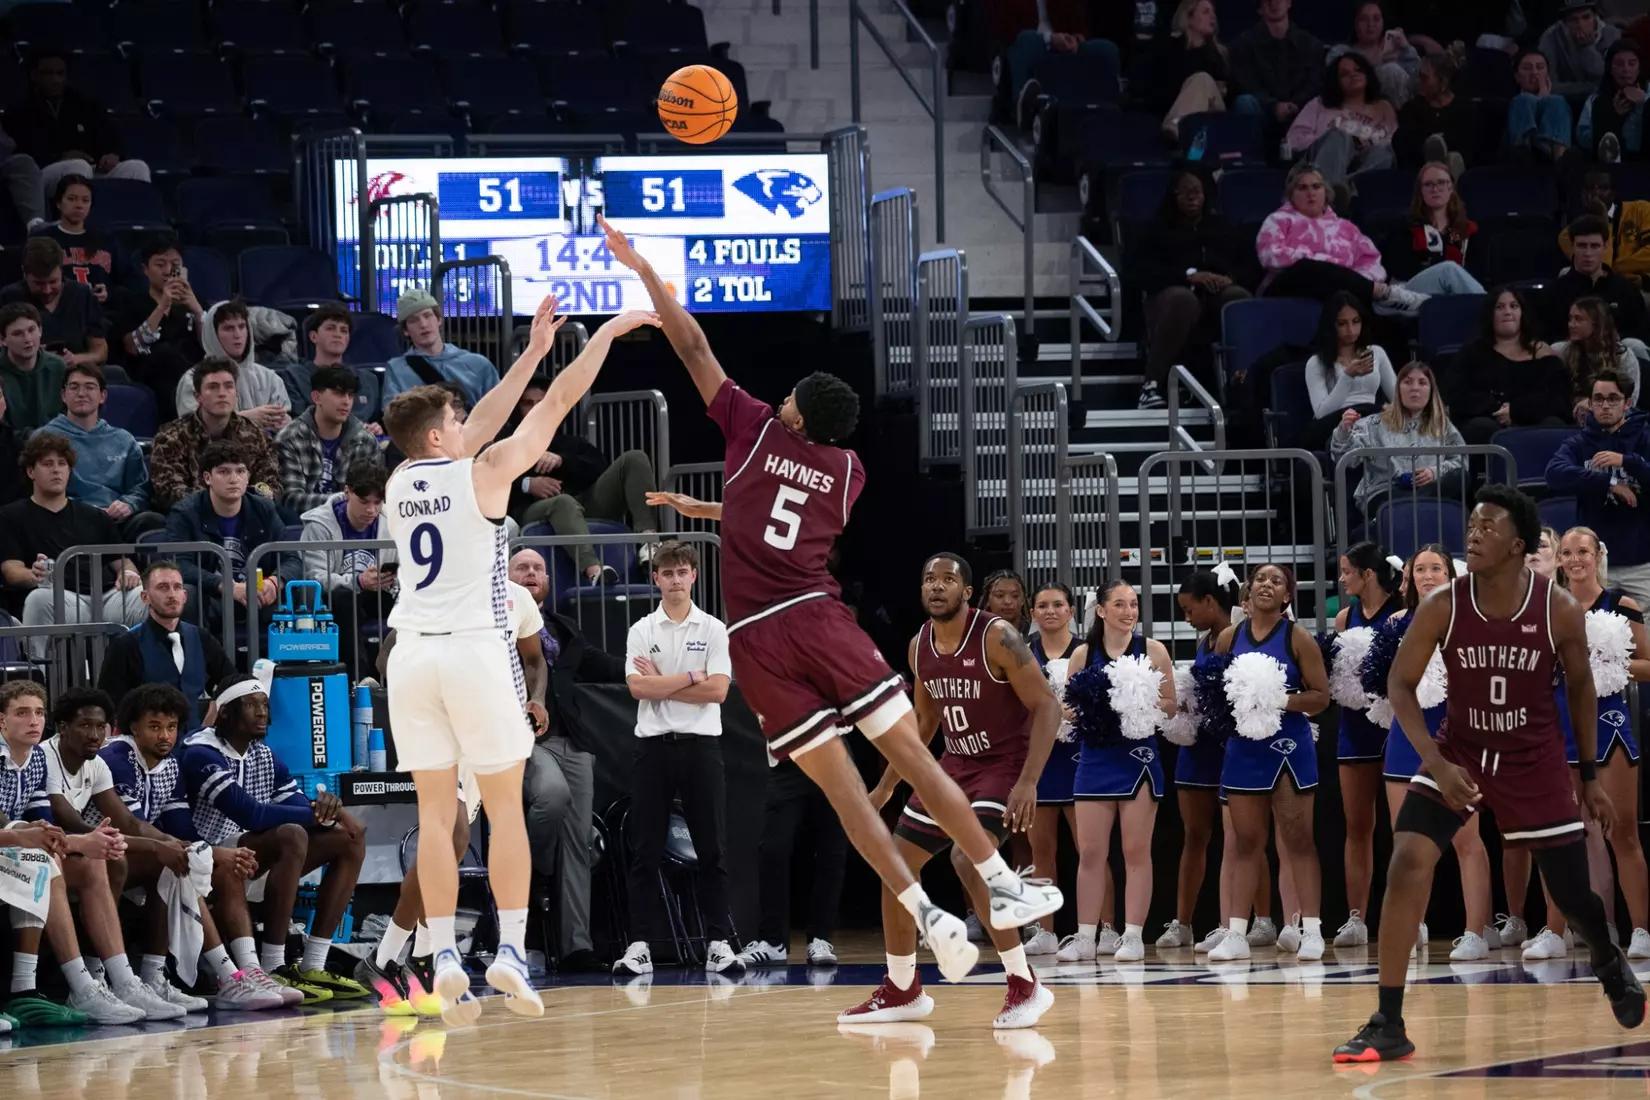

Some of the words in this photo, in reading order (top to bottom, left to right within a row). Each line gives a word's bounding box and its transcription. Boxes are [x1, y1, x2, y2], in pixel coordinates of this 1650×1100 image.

[479, 177, 523, 212] 51
[562, 179, 605, 207] VS
[642, 177, 686, 212] 51
[536, 238, 635, 271] 14:4
[689, 239, 707, 265] 4
[714, 238, 800, 265] FOULS
[551, 281, 623, 312] 2ND
[694, 276, 713, 302] 2
[719, 276, 772, 302] TOL
[764, 453, 835, 494] HAYNES
[398, 495, 451, 518] CONRAD
[763, 483, 810, 551] 5
[409, 522, 444, 592] 9
[279, 643, 331, 651] POWERADE
[1456, 645, 1541, 672] SOUTHERN
[923, 677, 981, 700] SOUTHERN
[1490, 675, 1507, 706] 0
[311, 682, 326, 764] POWERADE
[943, 705, 970, 733] 10
[1468, 707, 1528, 733] ILLINOIS
[944, 730, 992, 756] ILLINOIS
[354, 782, 384, 793] POWER
[385, 781, 418, 793] THROUG
